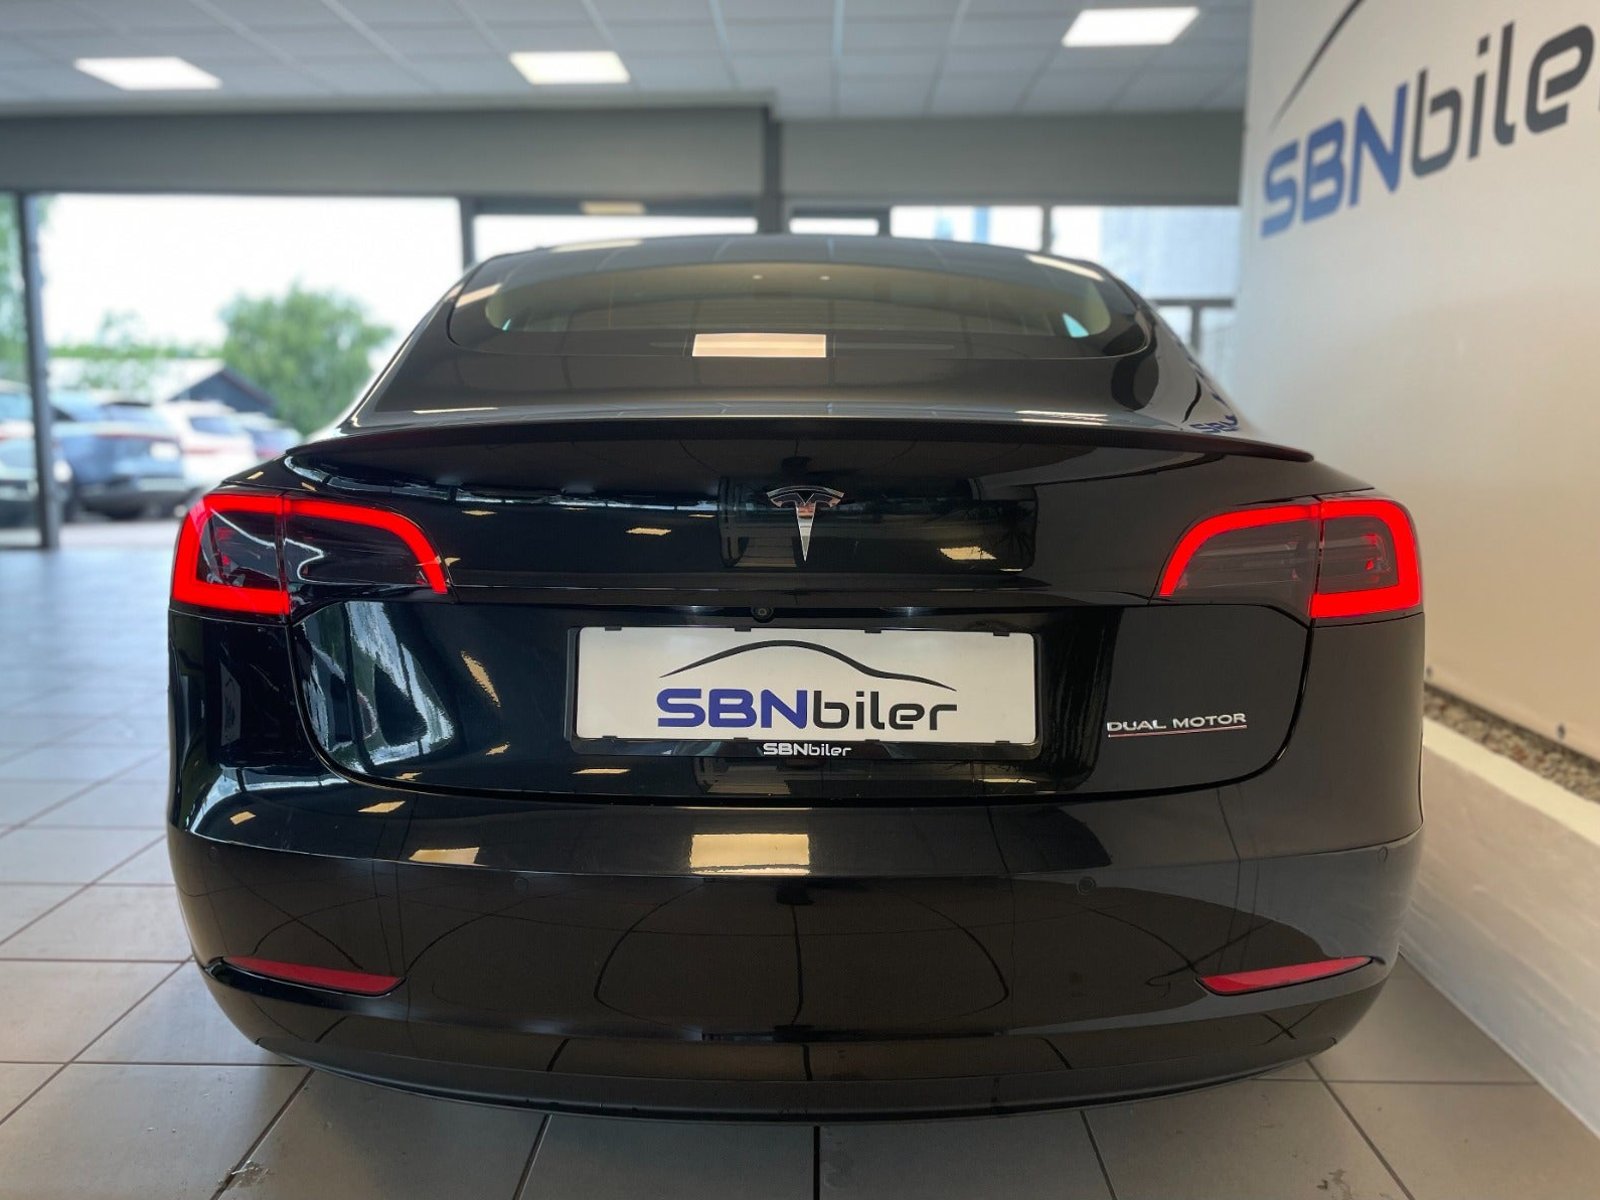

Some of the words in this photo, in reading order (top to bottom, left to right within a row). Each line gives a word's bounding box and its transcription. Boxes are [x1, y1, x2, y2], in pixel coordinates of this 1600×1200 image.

[1260, 21, 1600, 238] SBNbile
[656, 688, 957, 730] SBNbiler
[1106, 719, 1167, 732] DUAL
[1172, 712, 1247, 729] MOTOR
[763, 742, 852, 756] SBNbiler
